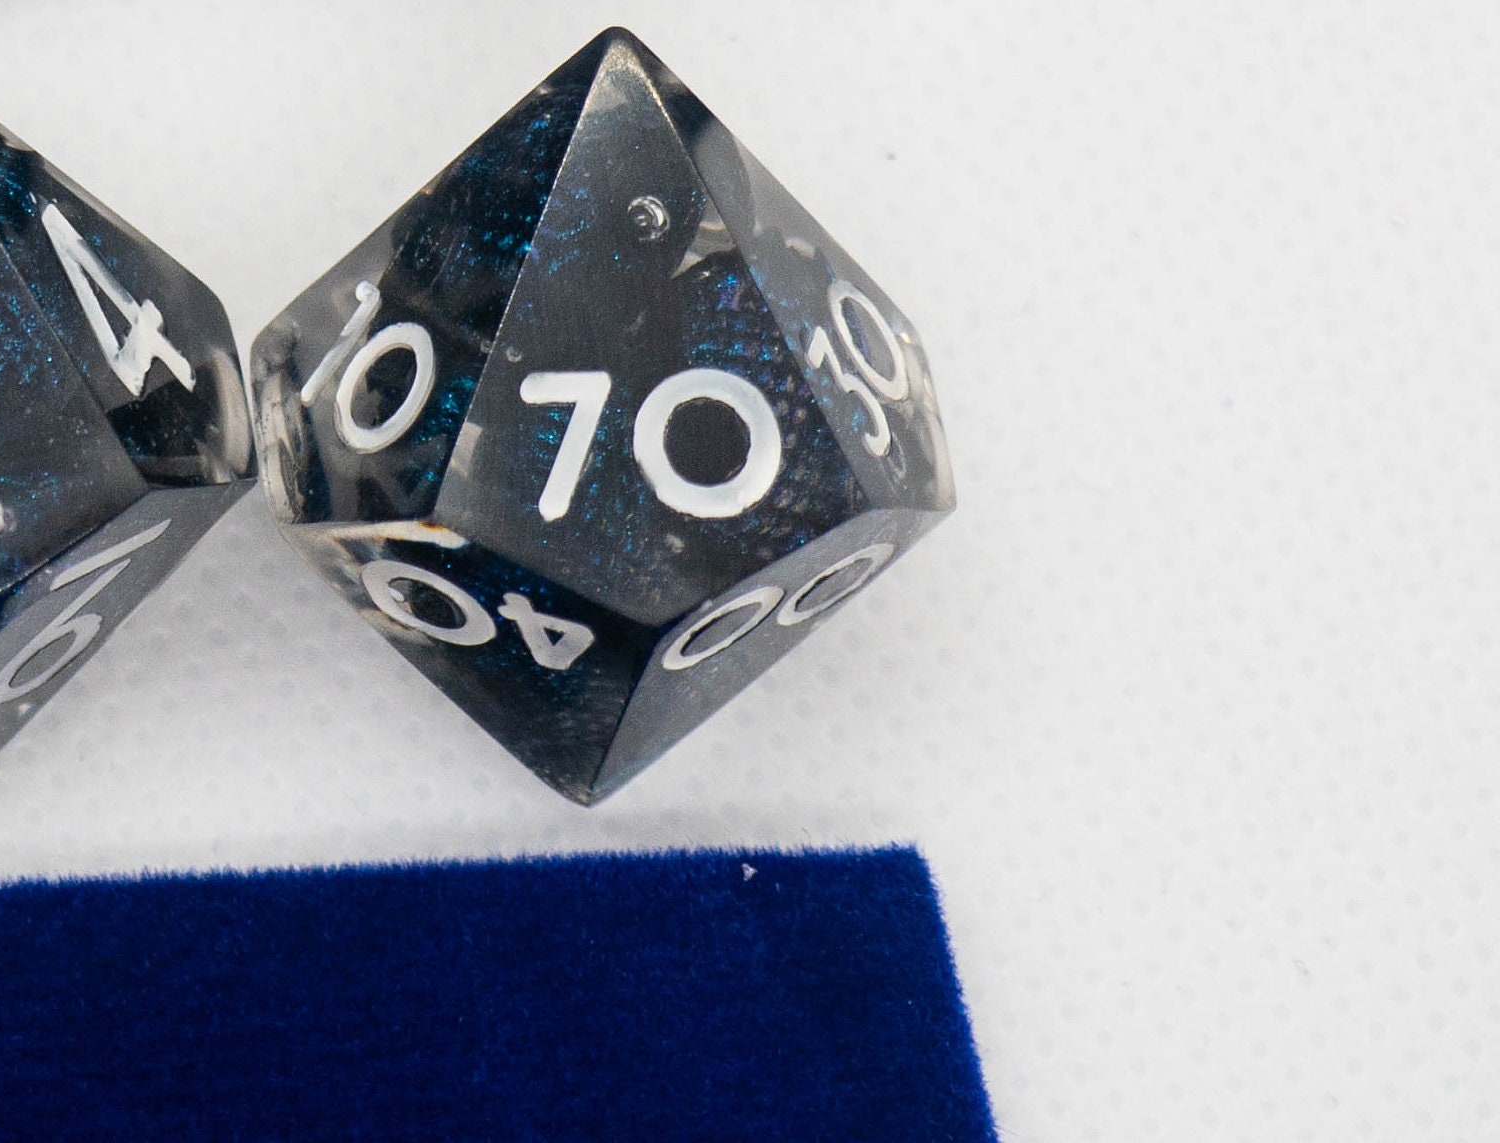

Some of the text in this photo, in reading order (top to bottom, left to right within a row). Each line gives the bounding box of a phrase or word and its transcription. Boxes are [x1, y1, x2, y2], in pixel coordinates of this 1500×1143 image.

[42, 203, 196, 396] 4
[302, 281, 435, 452] 10
[807, 281, 909, 457] 30
[520, 369, 782, 521] 70
[362, 558, 595, 670] 40
[661, 542, 895, 671] 00
